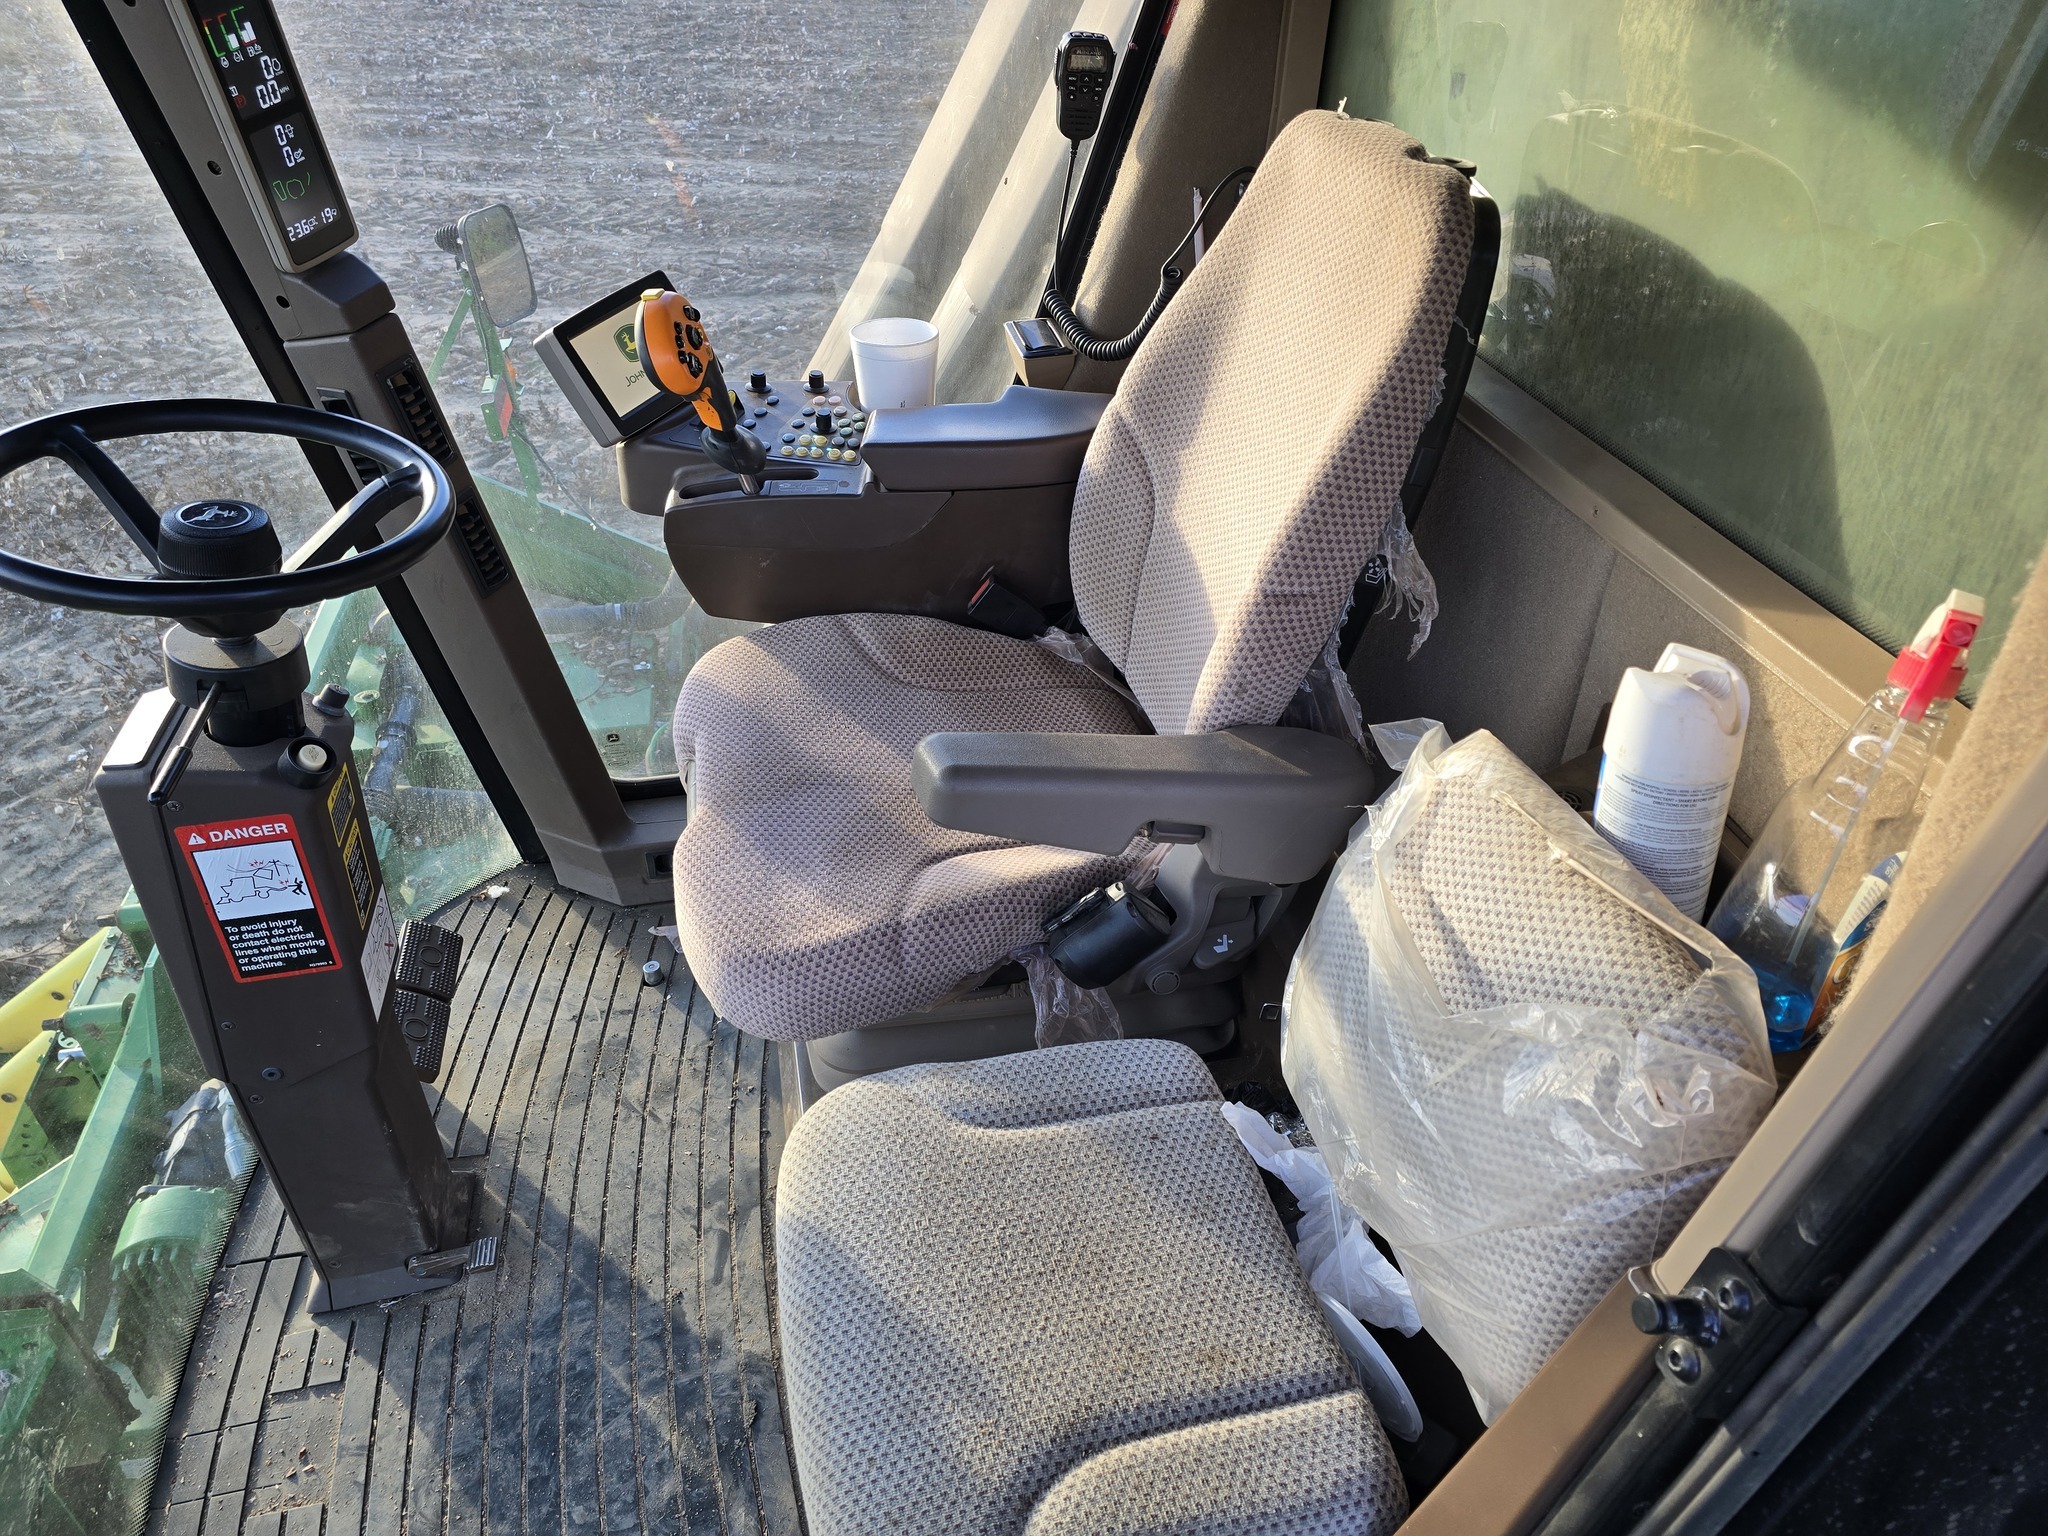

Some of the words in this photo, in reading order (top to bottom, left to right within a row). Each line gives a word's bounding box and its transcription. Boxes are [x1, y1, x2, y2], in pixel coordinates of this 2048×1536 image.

[260, 55, 274, 80] 0
[321, 207, 334, 224] 19
[209, 822, 288, 843] DANGER
[224, 926, 239, 934] To
[240, 921, 268, 932] avoid
[268, 918, 298, 928] injury
[241, 929, 271, 940] death
[271, 927, 286, 936] do
[286, 925, 304, 934] not
[232, 937, 270, 950] contact
[270, 931, 315, 944] electrical
[234, 948, 260, 957] lines
[260, 942, 288, 954] when
[288, 938, 326, 950] moving
[250, 950, 299, 963] operating
[298, 947, 318, 956] this
[241, 960, 287, 972] machine.
